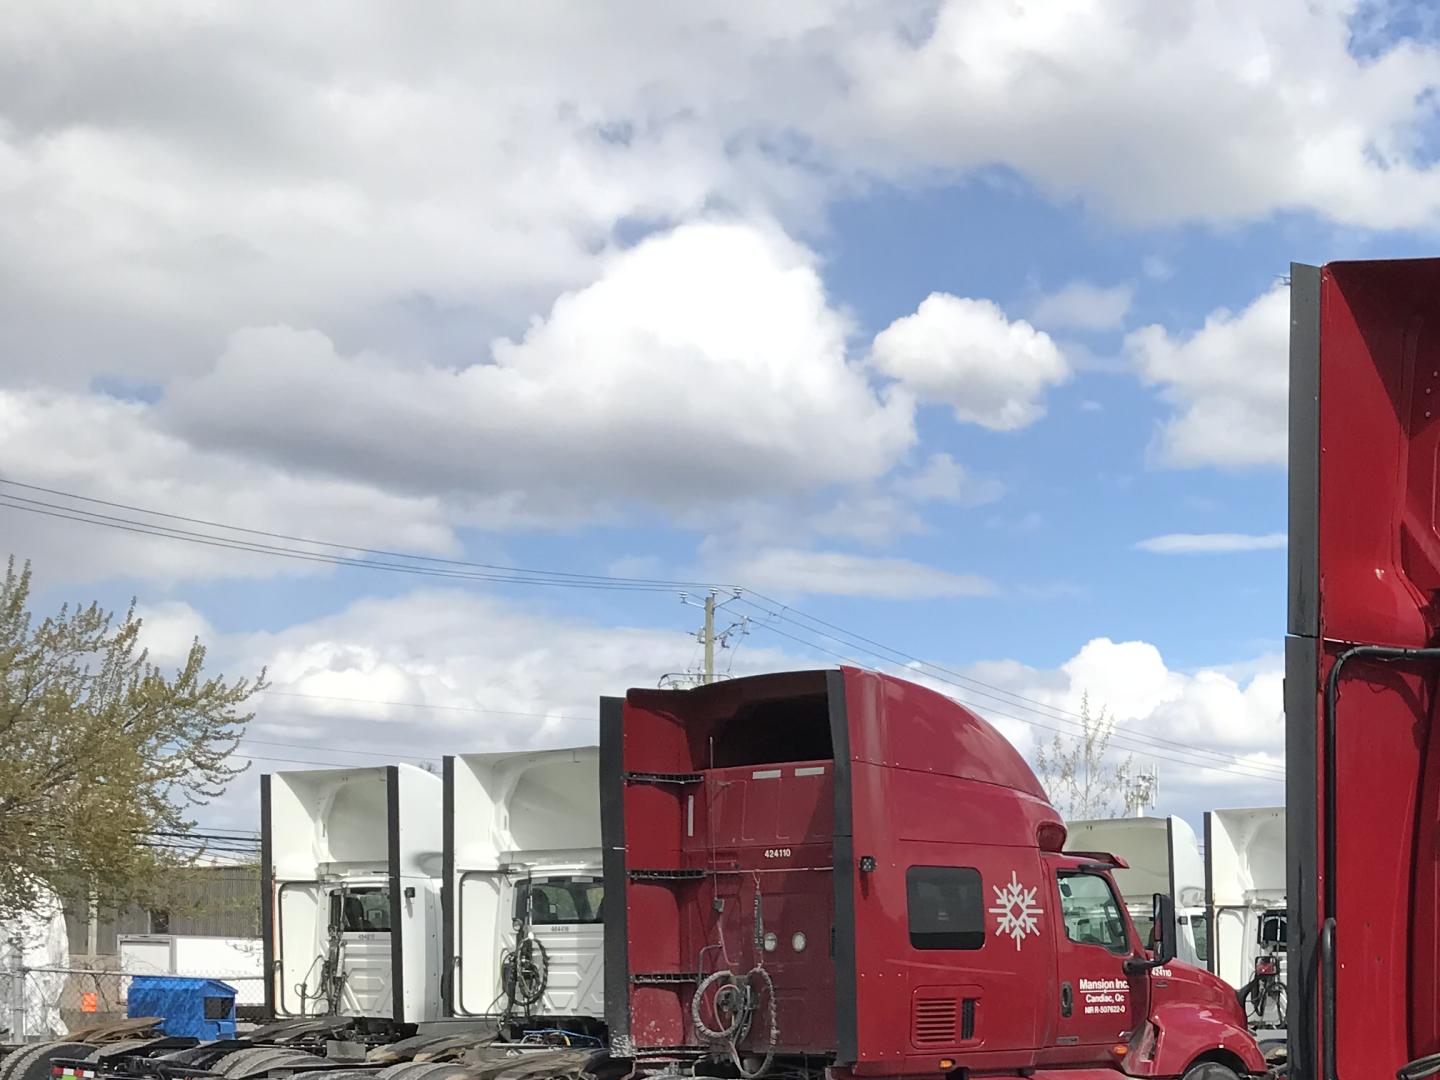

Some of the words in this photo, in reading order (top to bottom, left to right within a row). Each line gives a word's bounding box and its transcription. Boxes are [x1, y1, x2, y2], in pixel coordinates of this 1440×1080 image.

[764, 848, 791, 858] 424110
[1080, 979, 1115, 989] Mansion
[1115, 978, 1130, 989] Inc.
